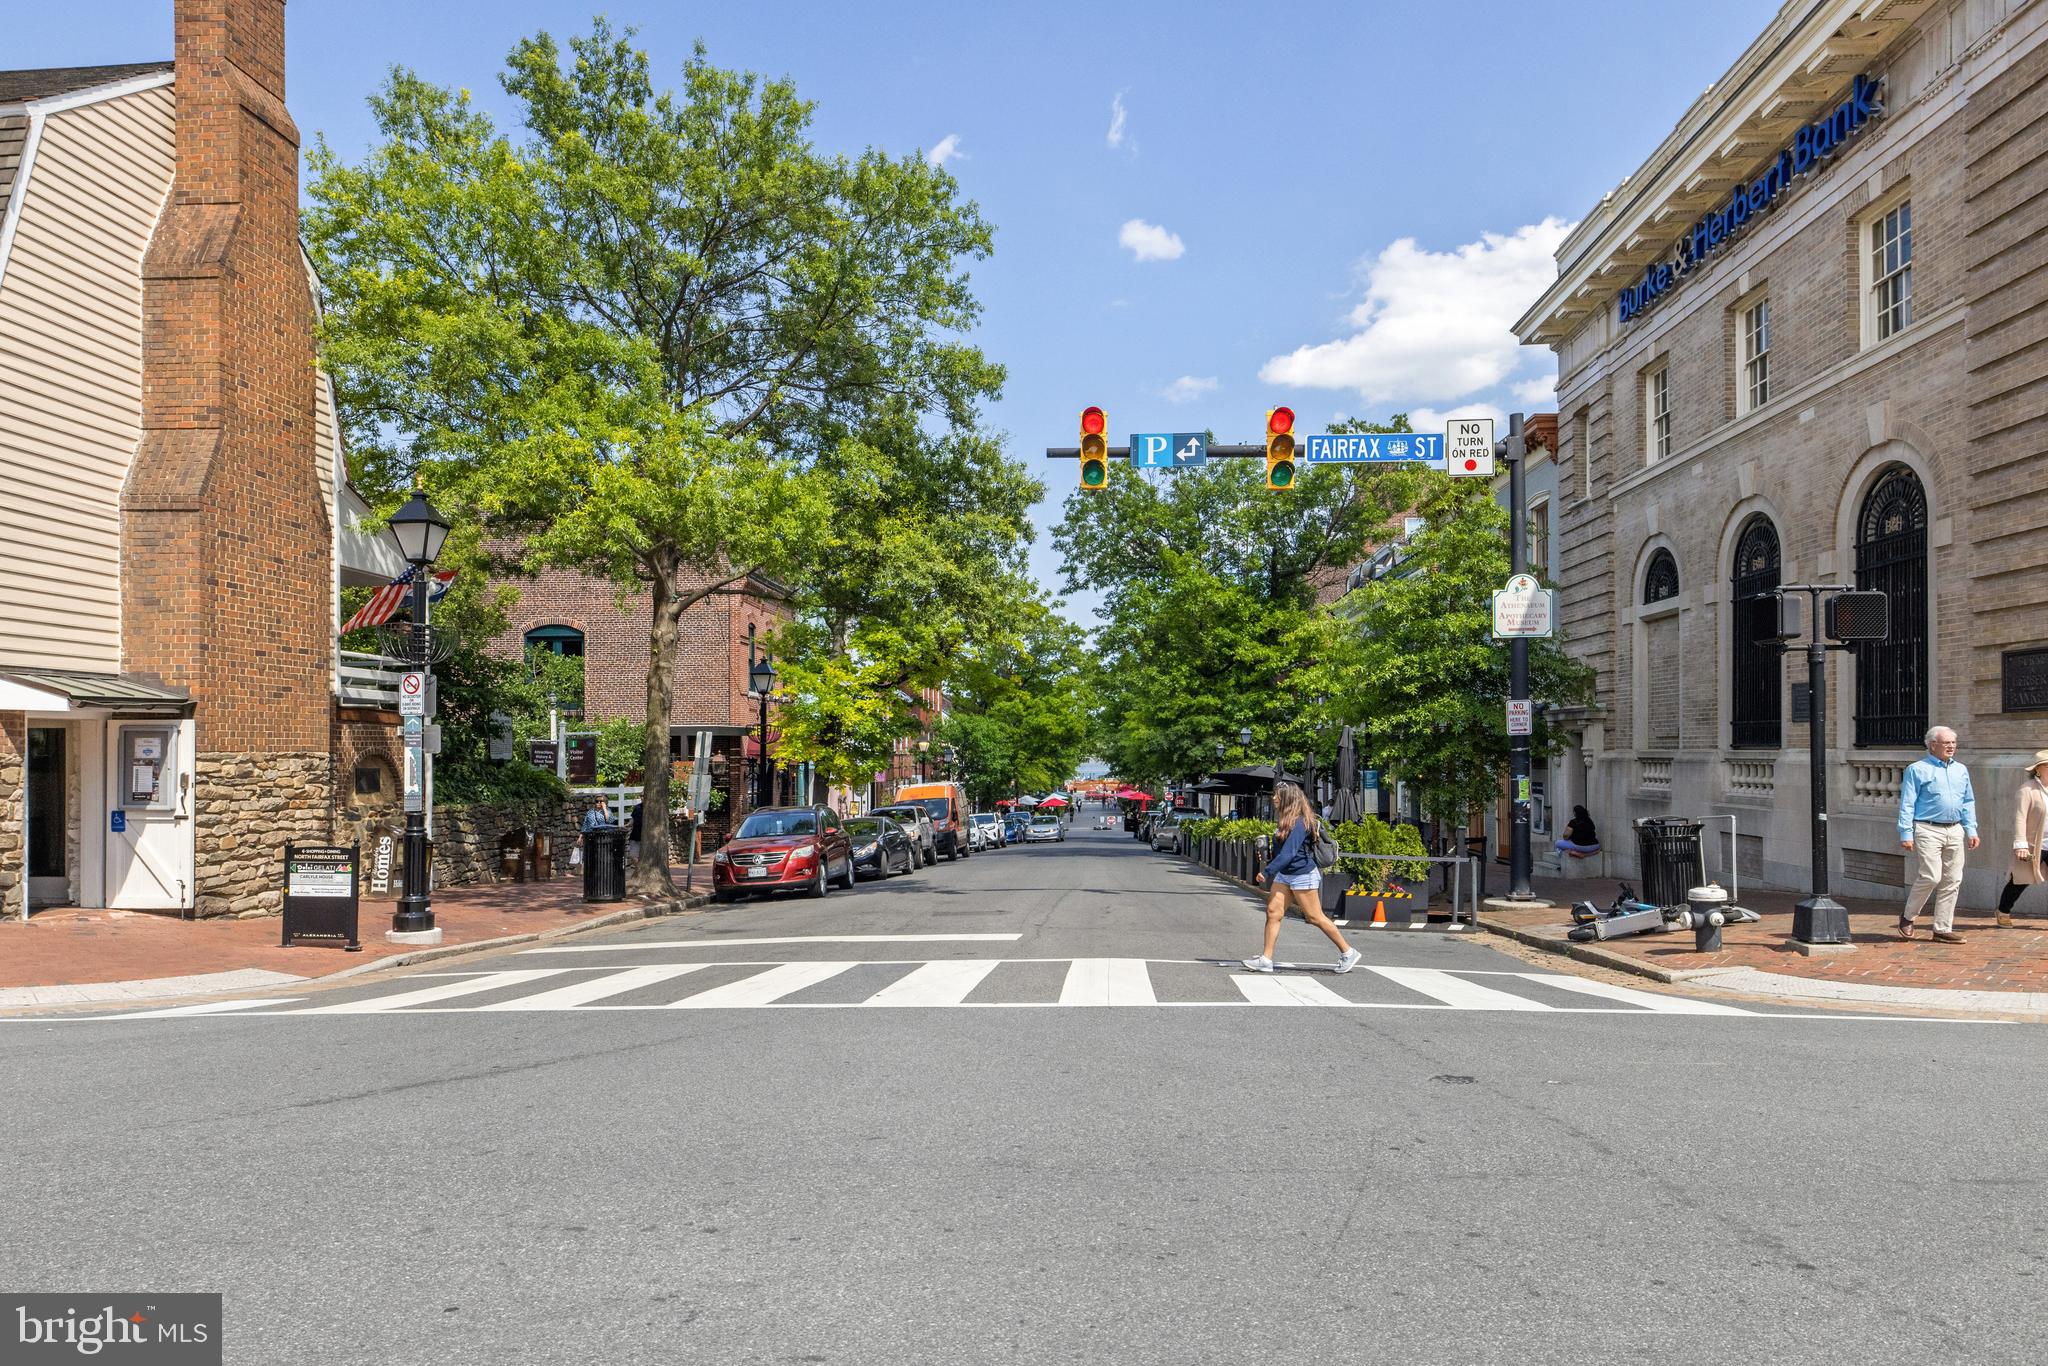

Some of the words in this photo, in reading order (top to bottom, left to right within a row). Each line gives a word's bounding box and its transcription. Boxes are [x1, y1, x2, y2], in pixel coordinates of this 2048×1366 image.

[1619, 264, 1672, 322] Burke
[1672, 239, 1688, 278] &
[1692, 150, 1793, 260] Herbert
[1794, 73, 1884, 175] Bank
[1460, 423, 1480, 435] NO
[1144, 436, 1167, 465] P
[1312, 438, 1380, 459] FAIRFAX
[1415, 437, 1437, 458] ST
[1457, 437, 1484, 447] TURN
[1452, 449, 1466, 458] ON
[1470, 448, 1489, 458] RED
[1499, 612, 1546, 620] APOTHECARY
[371, 836, 391, 893] Homes
